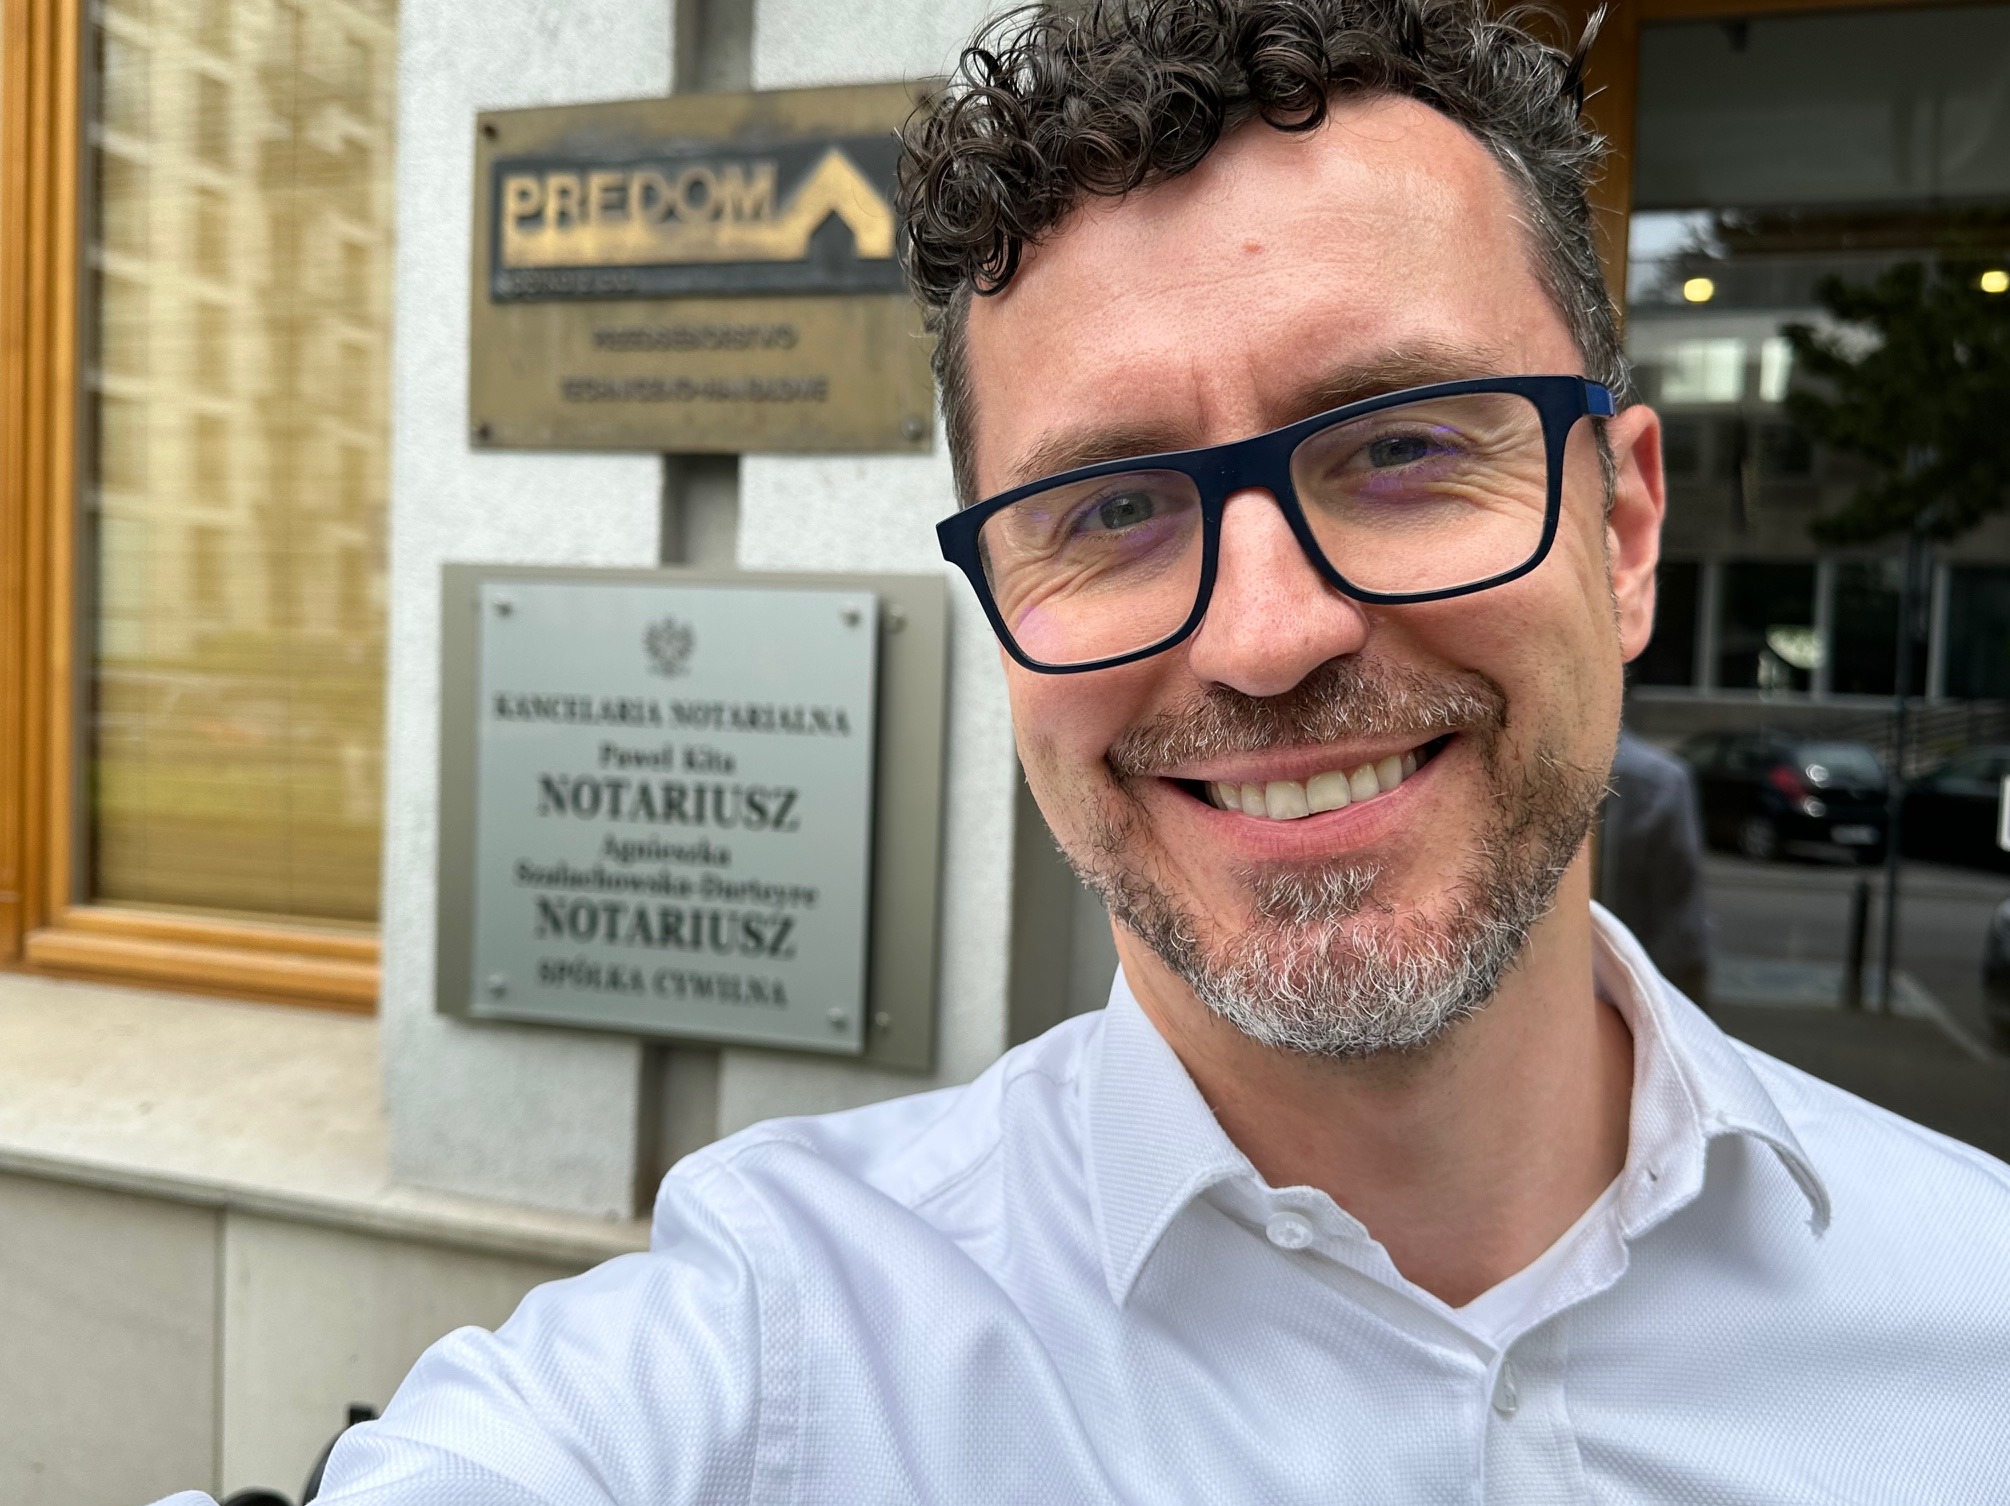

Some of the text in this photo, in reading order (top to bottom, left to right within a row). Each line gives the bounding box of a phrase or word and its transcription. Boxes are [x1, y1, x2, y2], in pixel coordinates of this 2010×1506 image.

[504, 164, 777, 224] PREDOM
[496, 692, 851, 735] KANCELARIA NOTARIALNA
[681, 745, 736, 776] Kita
[538, 775, 800, 831] NOTARIUSZ
[601, 835, 732, 868] Agnieszka
[534, 897, 796, 959] NOTARIUSZ
[653, 968, 788, 1007] CYWILNA
